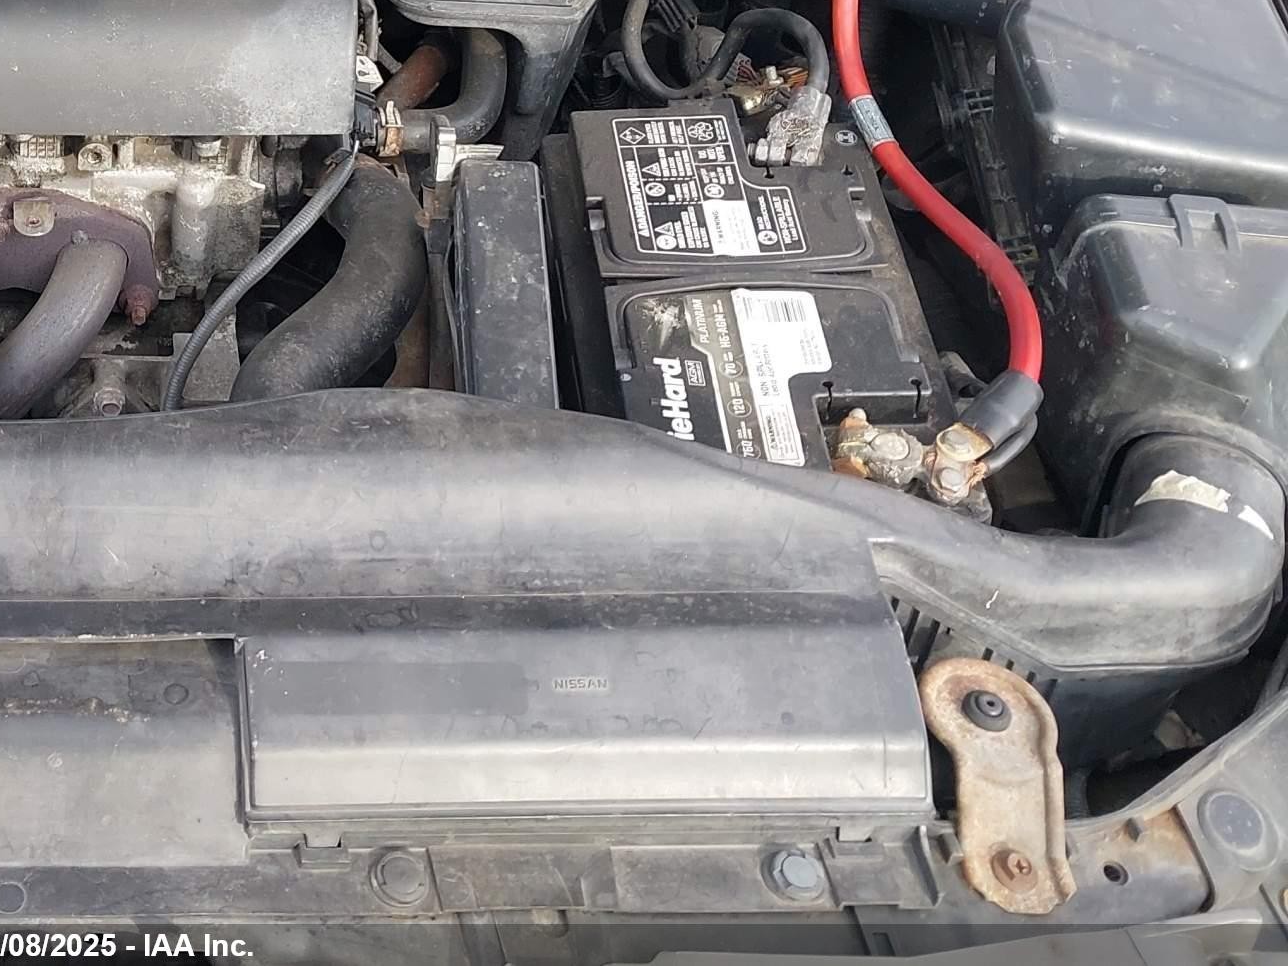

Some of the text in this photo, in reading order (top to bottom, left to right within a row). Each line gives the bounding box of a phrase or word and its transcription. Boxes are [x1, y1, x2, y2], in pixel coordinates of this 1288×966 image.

[626, 160, 648, 229] DANGER/POISON
[774, 196, 791, 244] NON-SPILLABLE
[692, 299, 709, 343] PLATINUM
[688, 363, 699, 383] AGM
[724, 363, 736, 374] 70
[652, 358, 695, 440] ieHard
[732, 399, 745, 414] 120
[553, 678, 609, 690] NISSAN
